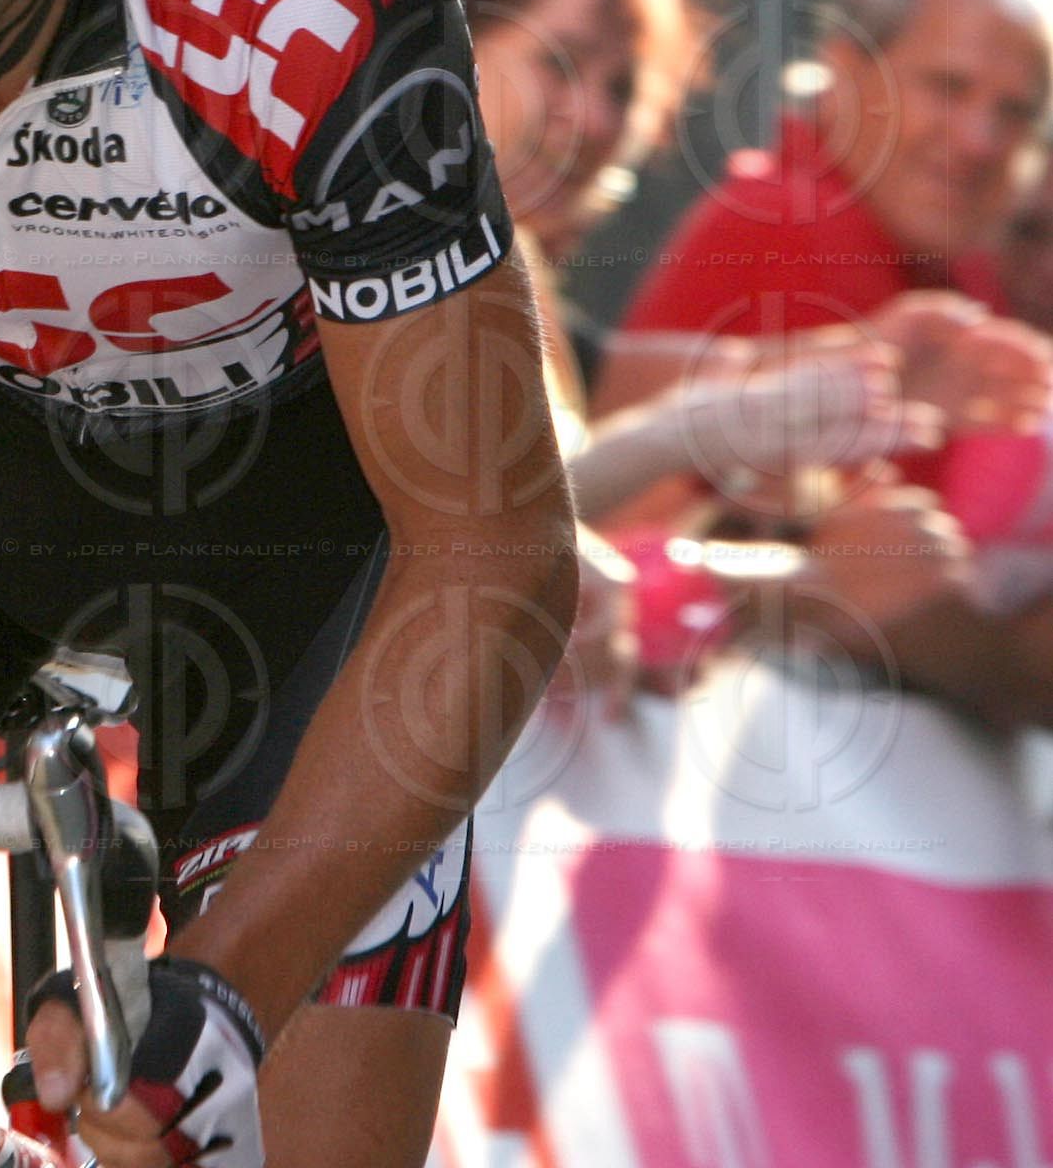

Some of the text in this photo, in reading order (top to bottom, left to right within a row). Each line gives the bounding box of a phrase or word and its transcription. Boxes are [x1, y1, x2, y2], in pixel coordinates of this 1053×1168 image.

[6, 122, 127, 168] Škoda
[291, 120, 473, 232] MAN
[308, 212, 502, 320] NOBILI
